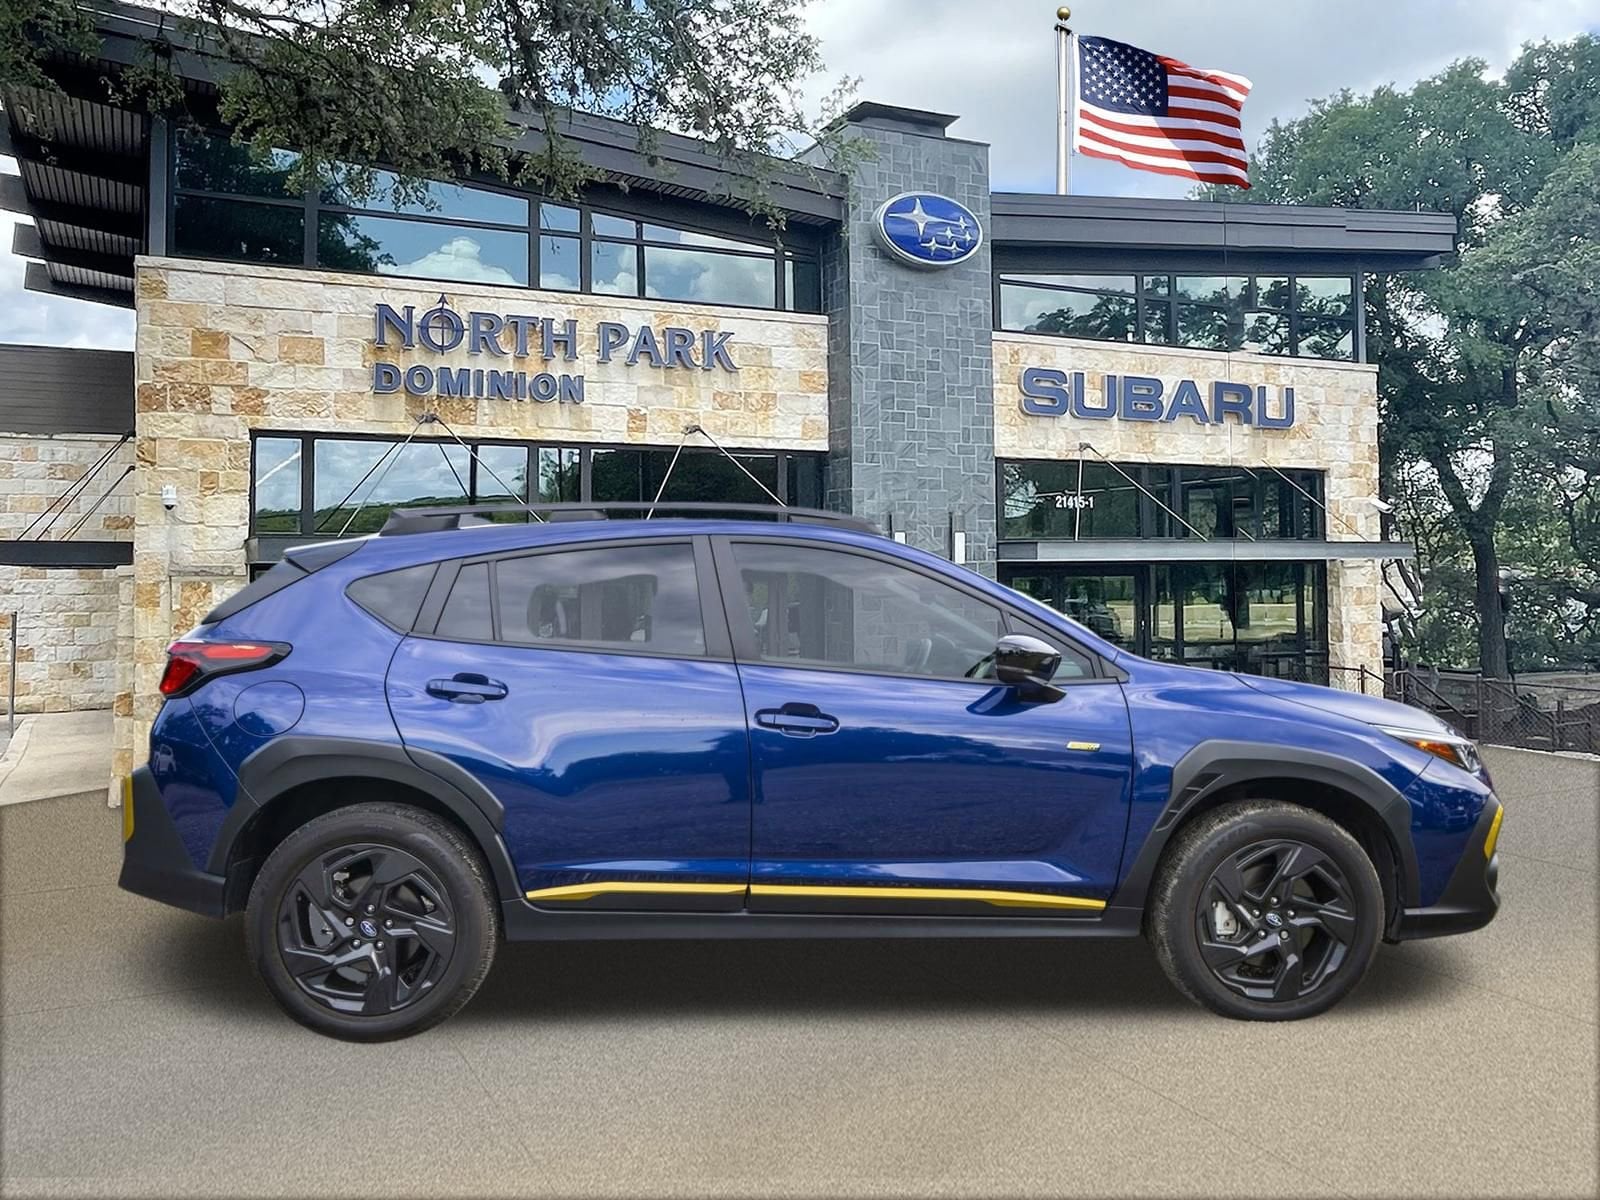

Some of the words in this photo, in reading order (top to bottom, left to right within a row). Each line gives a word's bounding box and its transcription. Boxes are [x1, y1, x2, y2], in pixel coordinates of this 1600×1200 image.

[374, 298, 579, 361] NORTH
[597, 321, 742, 373] PARK
[373, 362, 585, 405] DOMINION
[1018, 366, 1295, 430] SUBARU
